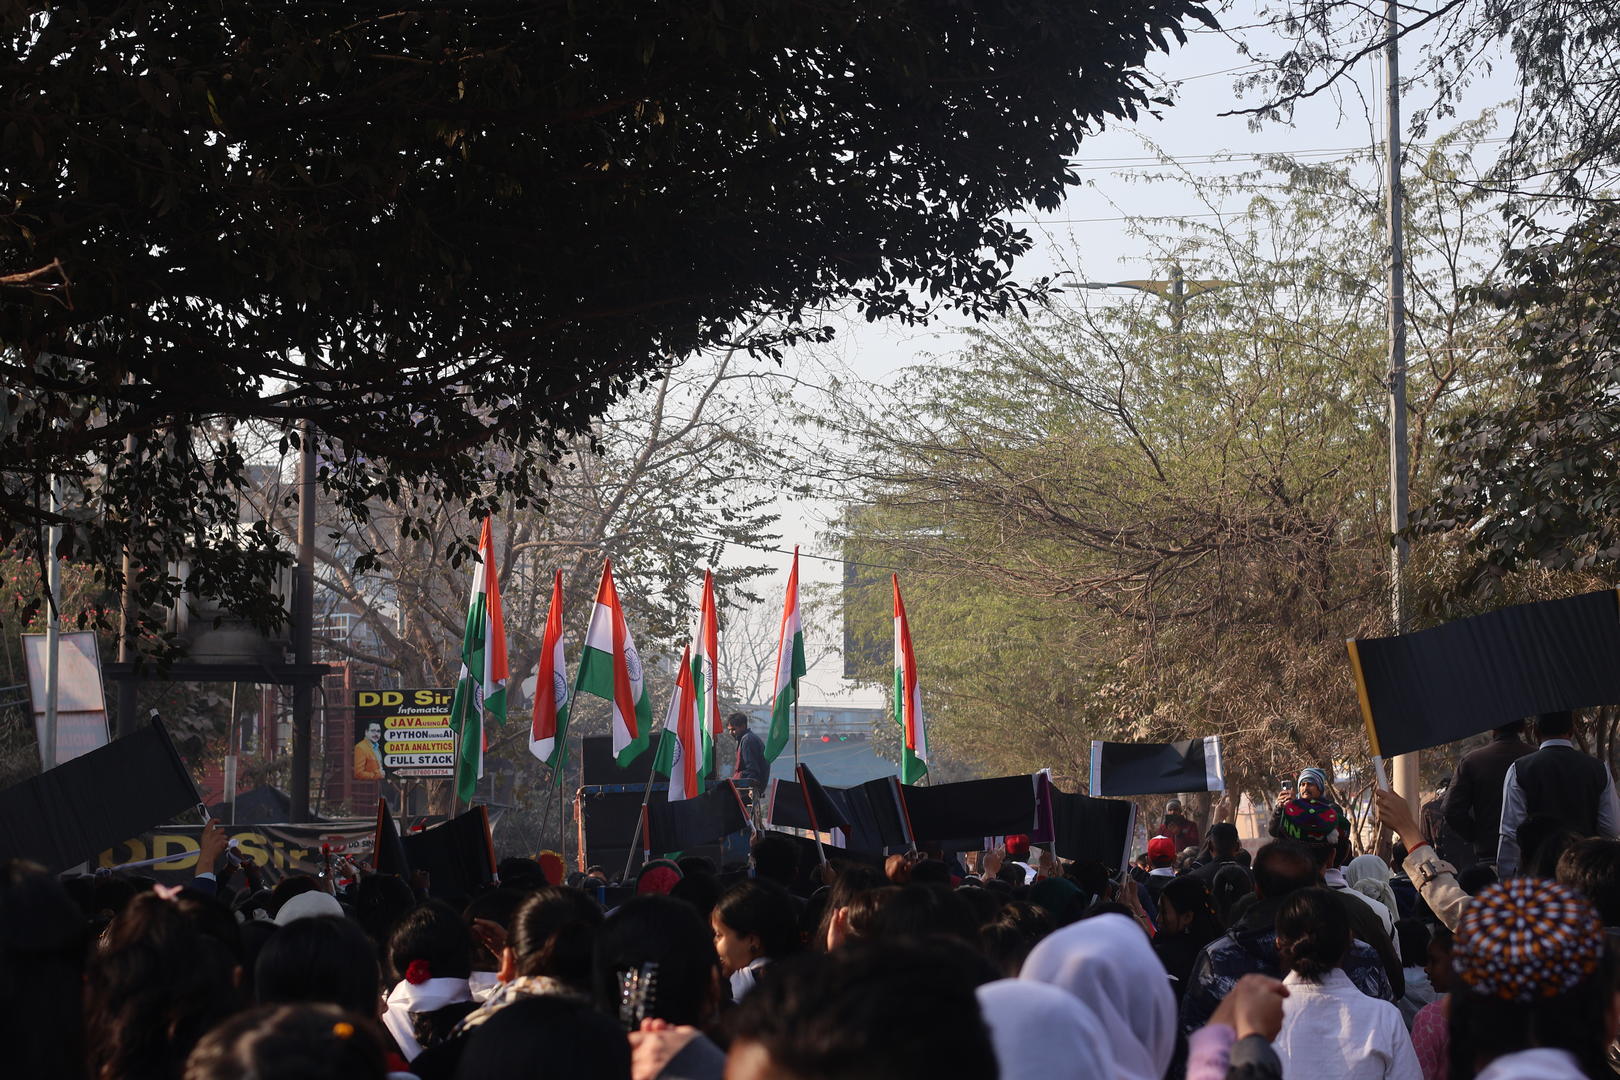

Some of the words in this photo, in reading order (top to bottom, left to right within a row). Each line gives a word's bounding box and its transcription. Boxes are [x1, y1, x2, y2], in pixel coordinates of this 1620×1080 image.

[359, 692, 404, 707] DD
[415, 690, 451, 705] Sir
[391, 718, 422, 727] JAVA
[390, 731, 428, 739] PYTHON
[443, 730, 452, 738] AI
[412, 743, 452, 751] ANALYTICS
[418, 756, 452, 764] STACK
[228, 832, 310, 870] Sir
